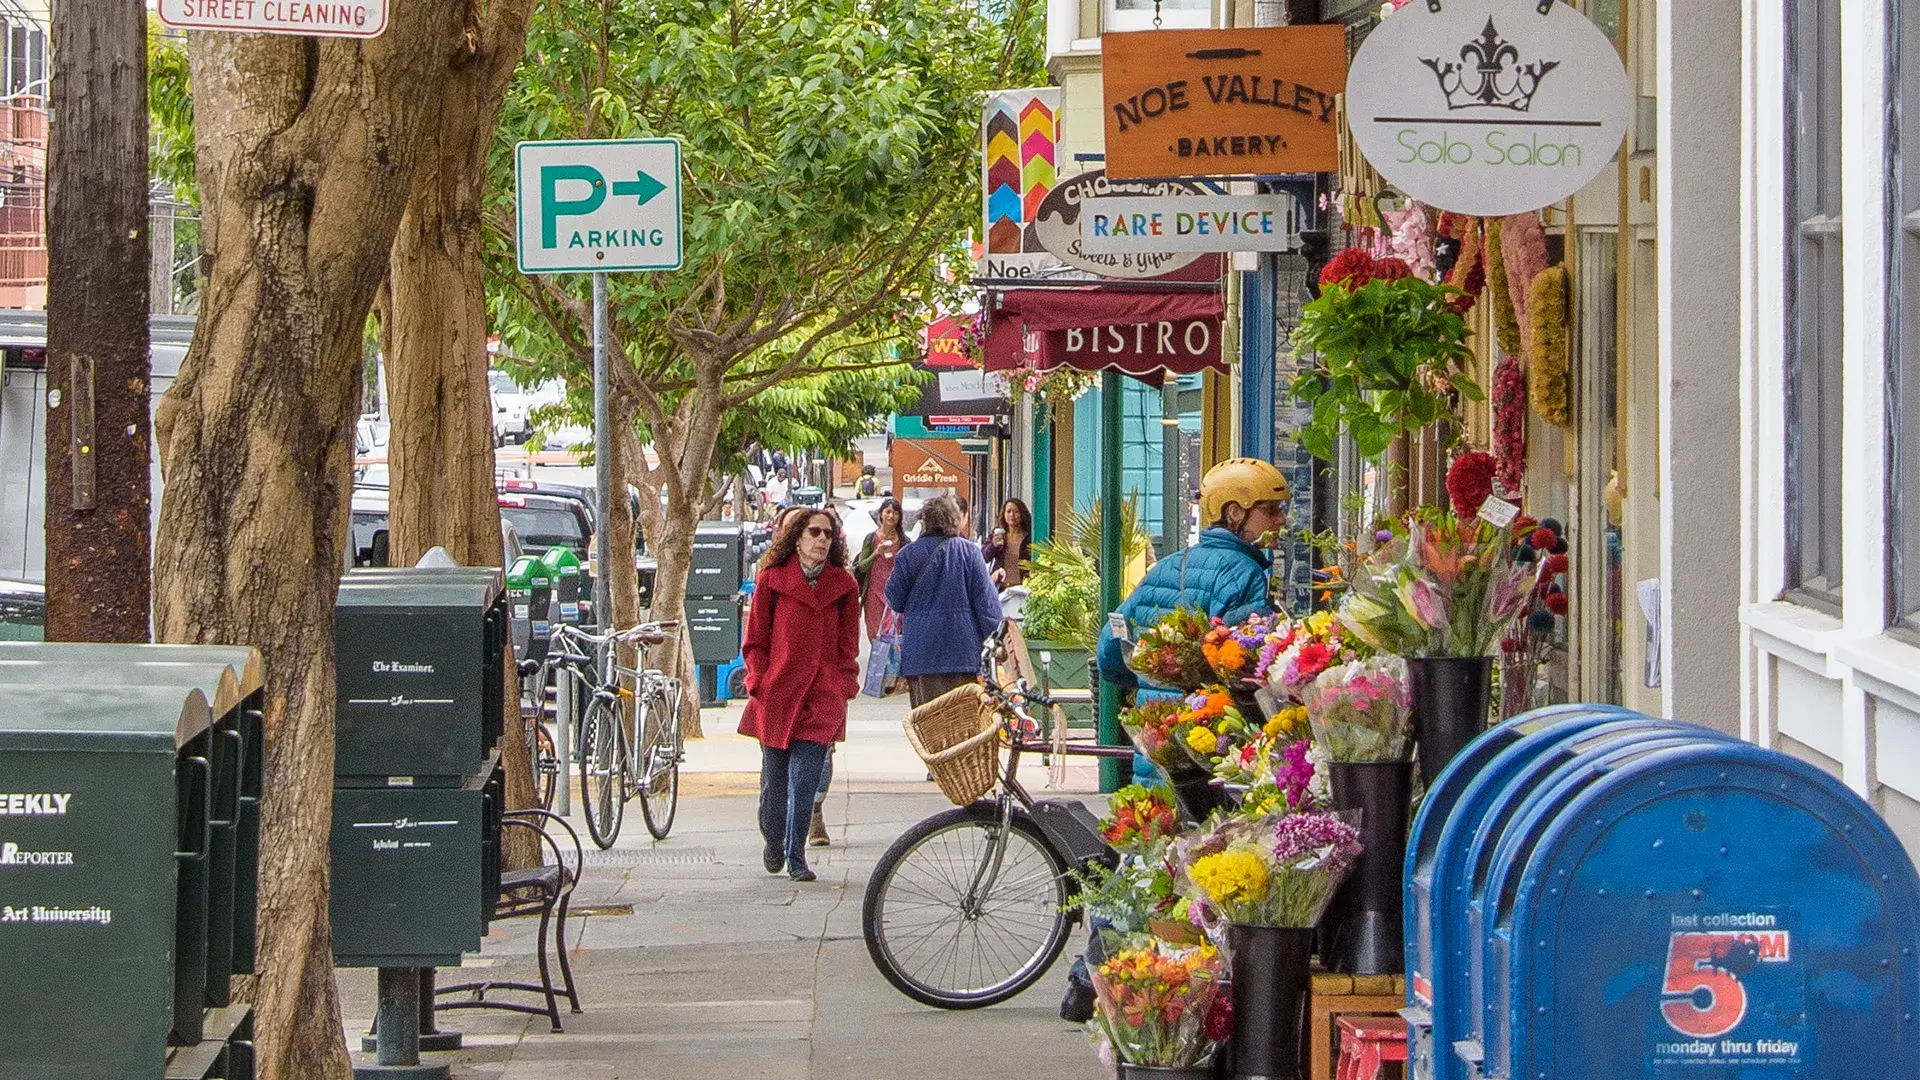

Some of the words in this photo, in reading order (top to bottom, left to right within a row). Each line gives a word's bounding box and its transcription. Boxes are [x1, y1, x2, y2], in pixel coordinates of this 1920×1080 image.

[183, 0, 255, 20] STREET
[263, 1, 366, 26] CLEANING
[1113, 80, 1189, 132] NOE
[1202, 75, 1336, 122] VALLEY
[1177, 135, 1282, 157] BAKERY
[1397, 129, 1472, 164] Solo
[1485, 130, 1581, 166] Salon
[540, 164, 663, 249] PARKING
[1094, 213, 1164, 237] RARE
[1176, 211, 1274, 236] DEVICE
[987, 260, 1031, 279] Noe
[1066, 321, 1210, 355] BISTRO
[903, 473, 933, 483] Griddle
[935, 473, 958, 483] Fresh
[372, 661, 390, 672] The
[1, 906, 29, 921] Art
[31, 906, 112, 924] University
[1671, 913, 1698, 927] last
[1702, 912, 1776, 927] collection
[1661, 931, 1747, 1037] 5
[1656, 1040, 1717, 1056] monday
[1720, 1040, 1752, 1053] thru
[1756, 1039, 1798, 1056] friday
